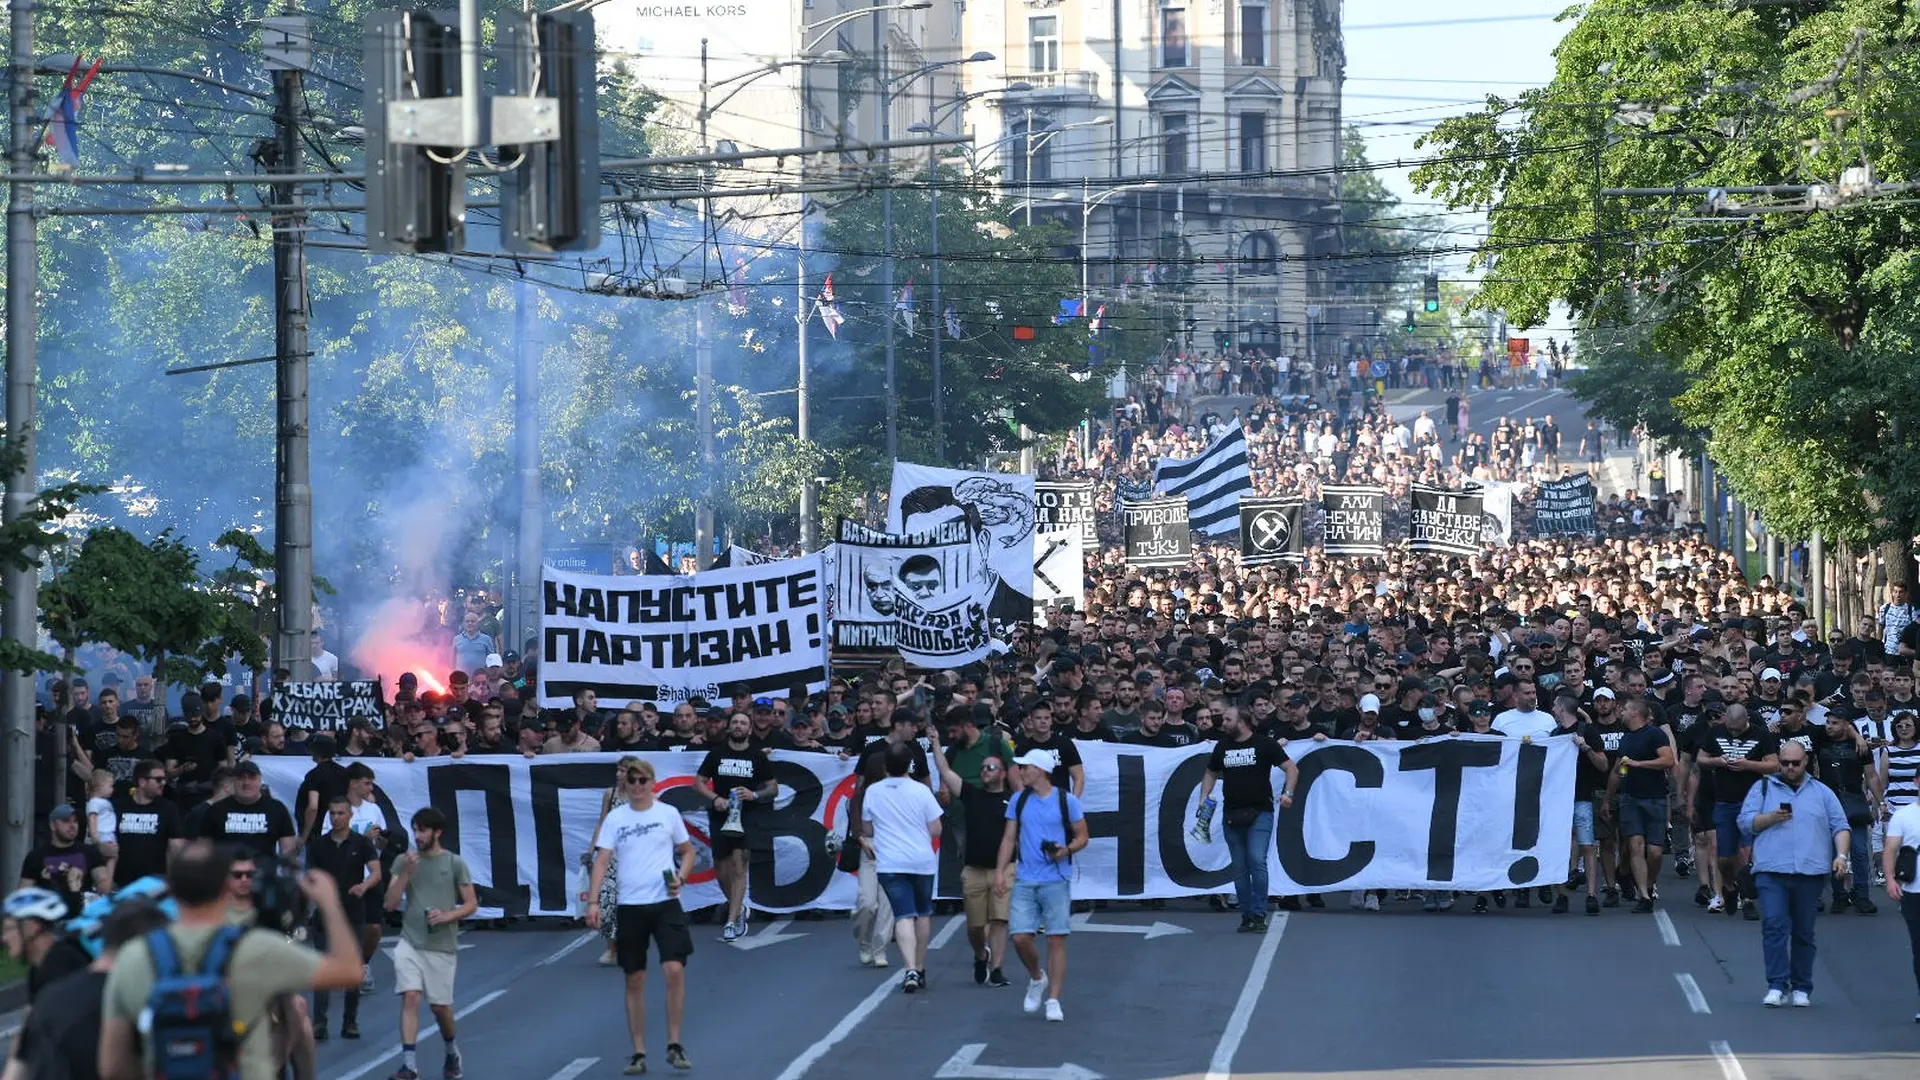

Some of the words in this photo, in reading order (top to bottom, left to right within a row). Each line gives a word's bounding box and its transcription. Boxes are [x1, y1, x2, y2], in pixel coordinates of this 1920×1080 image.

[636, 6, 701, 17] MICHAEL
[706, 5, 747, 16] KORS
[1341, 496, 1372, 509] АЛИ
[1436, 496, 1457, 513] ДА
[1058, 507, 1094, 522] НАС
[1124, 506, 1189, 526] ПРИВОДЕ
[1411, 509, 1481, 531] ЗАУСТАВЕ
[1152, 525, 1163, 540] И
[1416, 525, 1475, 545] ПОРУКУ
[1136, 540, 1179, 556] ТУКУ
[557, 557, 587, 567] online
[544, 570, 817, 623] НАПУСТИТЕ
[545, 620, 791, 669] ПАРТИЗАН
[807, 613, 821, 648] !
[272, 691, 379, 717] КУМОДРАЖ
